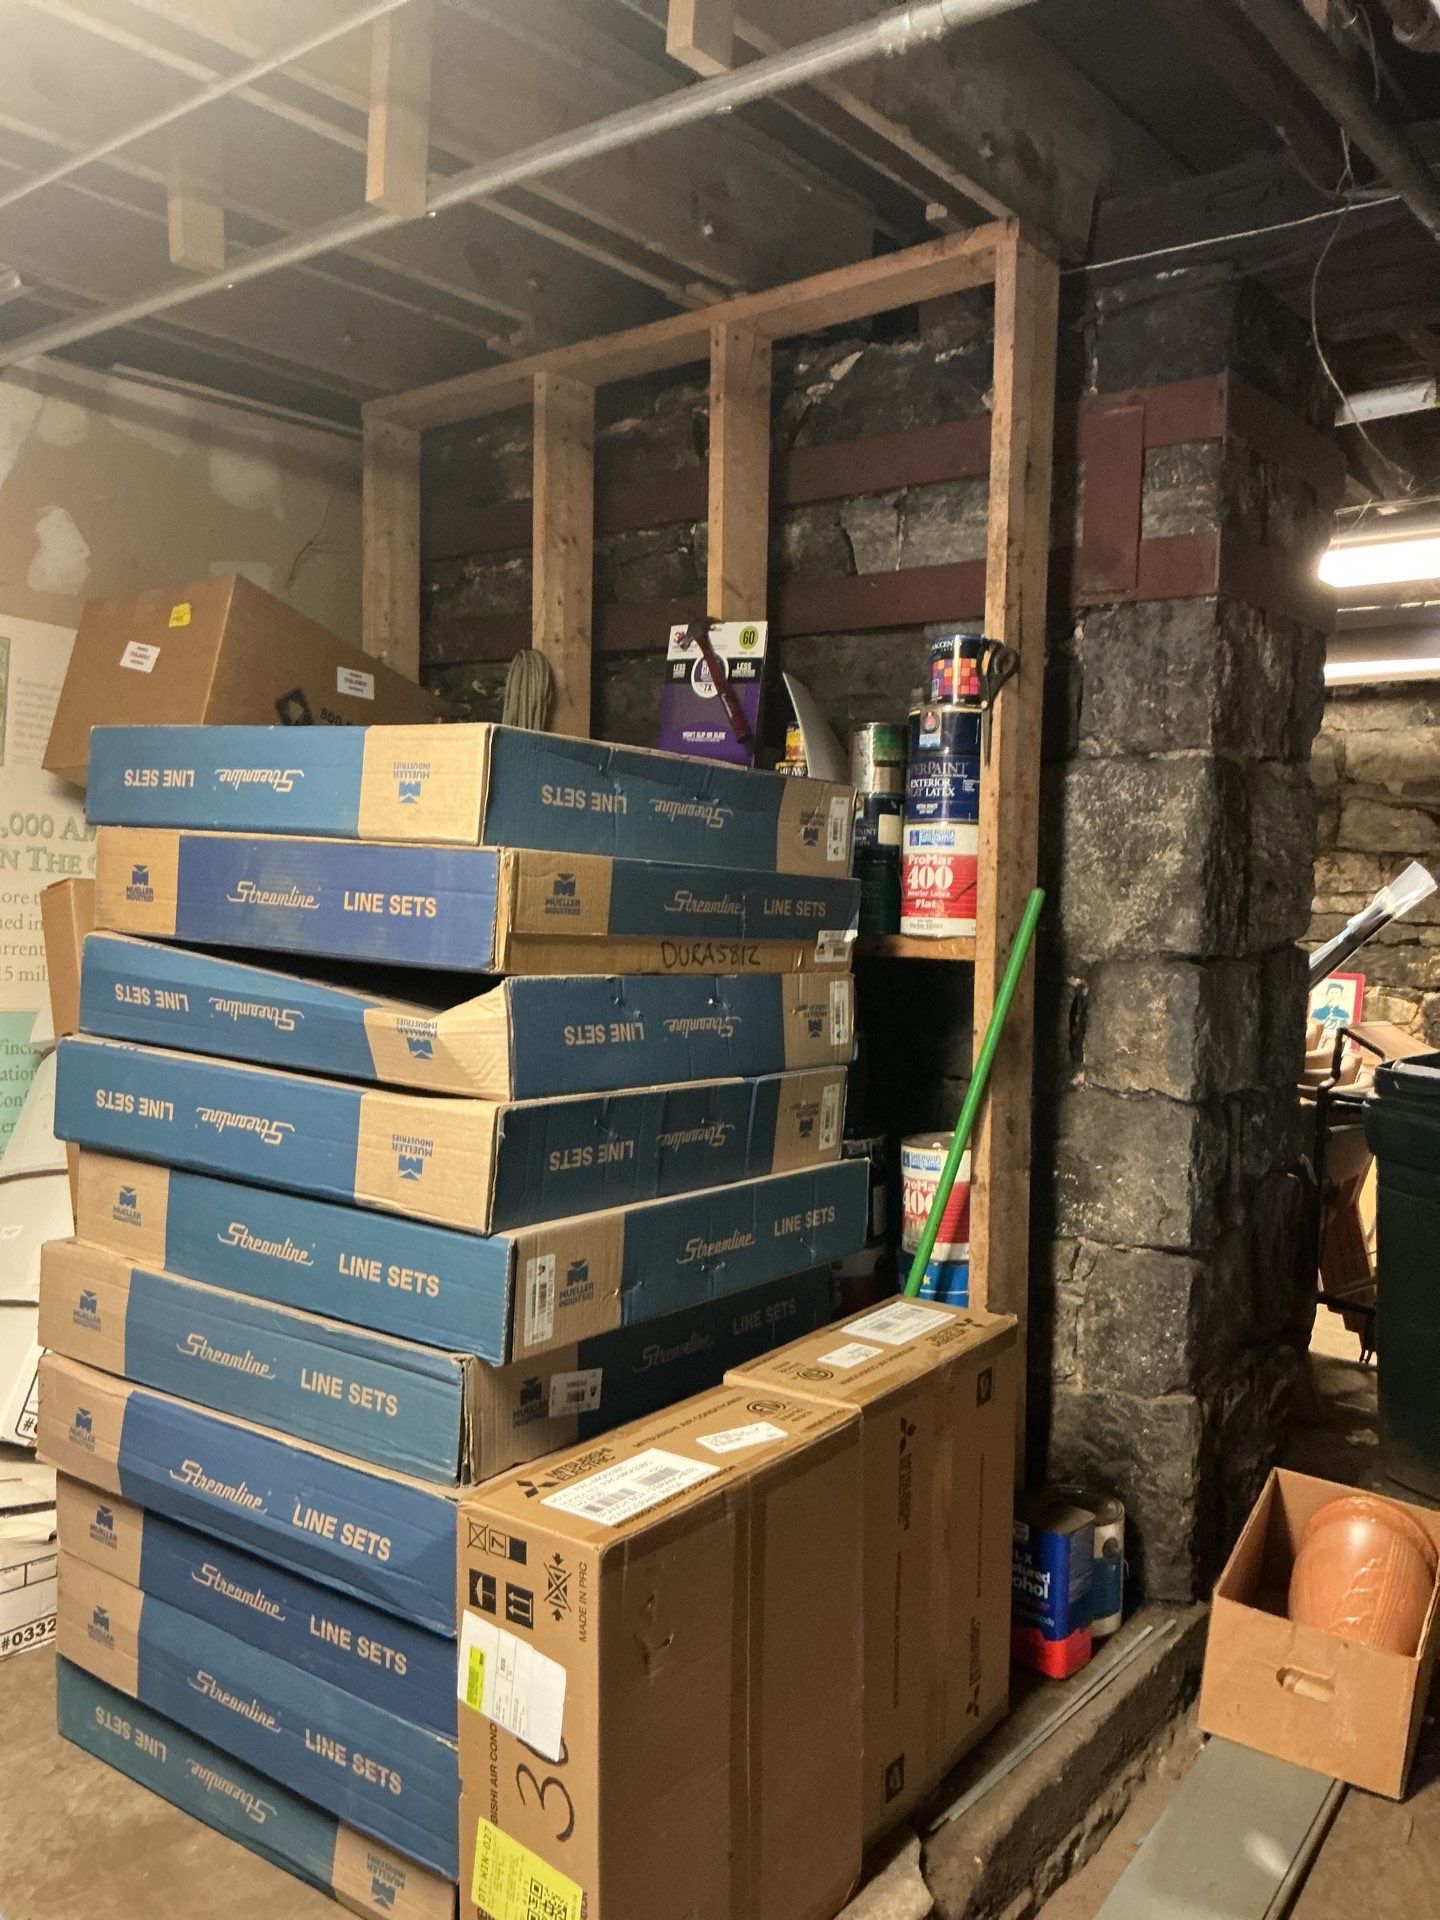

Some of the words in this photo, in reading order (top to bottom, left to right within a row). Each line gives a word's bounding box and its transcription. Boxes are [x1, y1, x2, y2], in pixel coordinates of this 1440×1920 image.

[743, 631, 755, 645] 60
[124, 769, 158, 786] SETS
[163, 770, 194, 788] LINE
[214, 769, 304, 792] Streamline
[392, 770, 430, 779] MUELLER
[910, 777, 951, 788] EXTERIOR
[541, 784, 586, 809] SETS
[591, 791, 627, 814] LINE
[925, 786, 956, 797] LATEX
[649, 796, 733, 829] Streamline
[25, 846, 81, 874] THE
[908, 854, 954, 865] ProMar
[907, 865, 954, 890] 400
[227, 881, 320, 909] Streamline
[343, 892, 384, 914] LINE
[389, 895, 437, 918] SETS
[545, 896, 581, 908] MUELLER
[664, 889, 744, 916] Streamline
[763, 900, 791, 916] LINE
[795, 901, 827, 918] SETS
[915, 899, 937, 908] Flat
[115, 984, 151, 1006] SETS
[155, 989, 189, 1012] LINE
[208, 996, 305, 1031] Streamline
[565, 1025, 606, 1046] SETS
[611, 1021, 644, 1042] LINE
[663, 1015, 742, 1039] Streamline
[95, 1089, 134, 1114] SETS
[138, 1097, 174, 1121] LINE
[196, 1107, 295, 1145] Streamline
[656, 1122, 734, 1149] Streamline
[392, 1142, 433, 1157] MUELLER
[549, 1149, 592, 1171] SETS
[598, 1140, 634, 1163] LINE
[113, 1205, 141, 1219] MUELLER
[676, 1230, 755, 1265] Streamline
[774, 1213, 800, 1238] LINE
[804, 1206, 836, 1231] SETS
[217, 1222, 314, 1266] Streamline
[338, 1253, 381, 1283] LINE
[386, 1266, 440, 1297] SETS
[559, 1282, 594, 1300] MUELLER
[633, 1334, 715, 1371] Streamline
[733, 1309, 761, 1335] LINE
[765, 1298, 797, 1328] SETS
[176, 1332, 276, 1380] Streamline
[300, 1368, 343, 1399] LINE
[347, 1381, 398, 1416] SETS
[169, 1458, 270, 1514] Streamline
[292, 1506, 338, 1541] LINE
[340, 1522, 391, 1562] SETS
[578, 1561, 588, 1589] PRC
[578, 1591, 587, 1605] IN
[190, 1562, 286, 1623] Streamline
[309, 1614, 351, 1651] LINE
[356, 1635, 408, 1676] SETS
[577, 1605, 588, 1643] MADE
[95, 1706, 130, 1738] SETS
[187, 1670, 281, 1734] Streamline
[305, 1728, 347, 1767] LINE
[352, 1752, 402, 1795] SETS
[135, 1726, 167, 1762] LINE
[490, 1766, 499, 1788] AIR
[186, 1758, 277, 1824] Streamline
